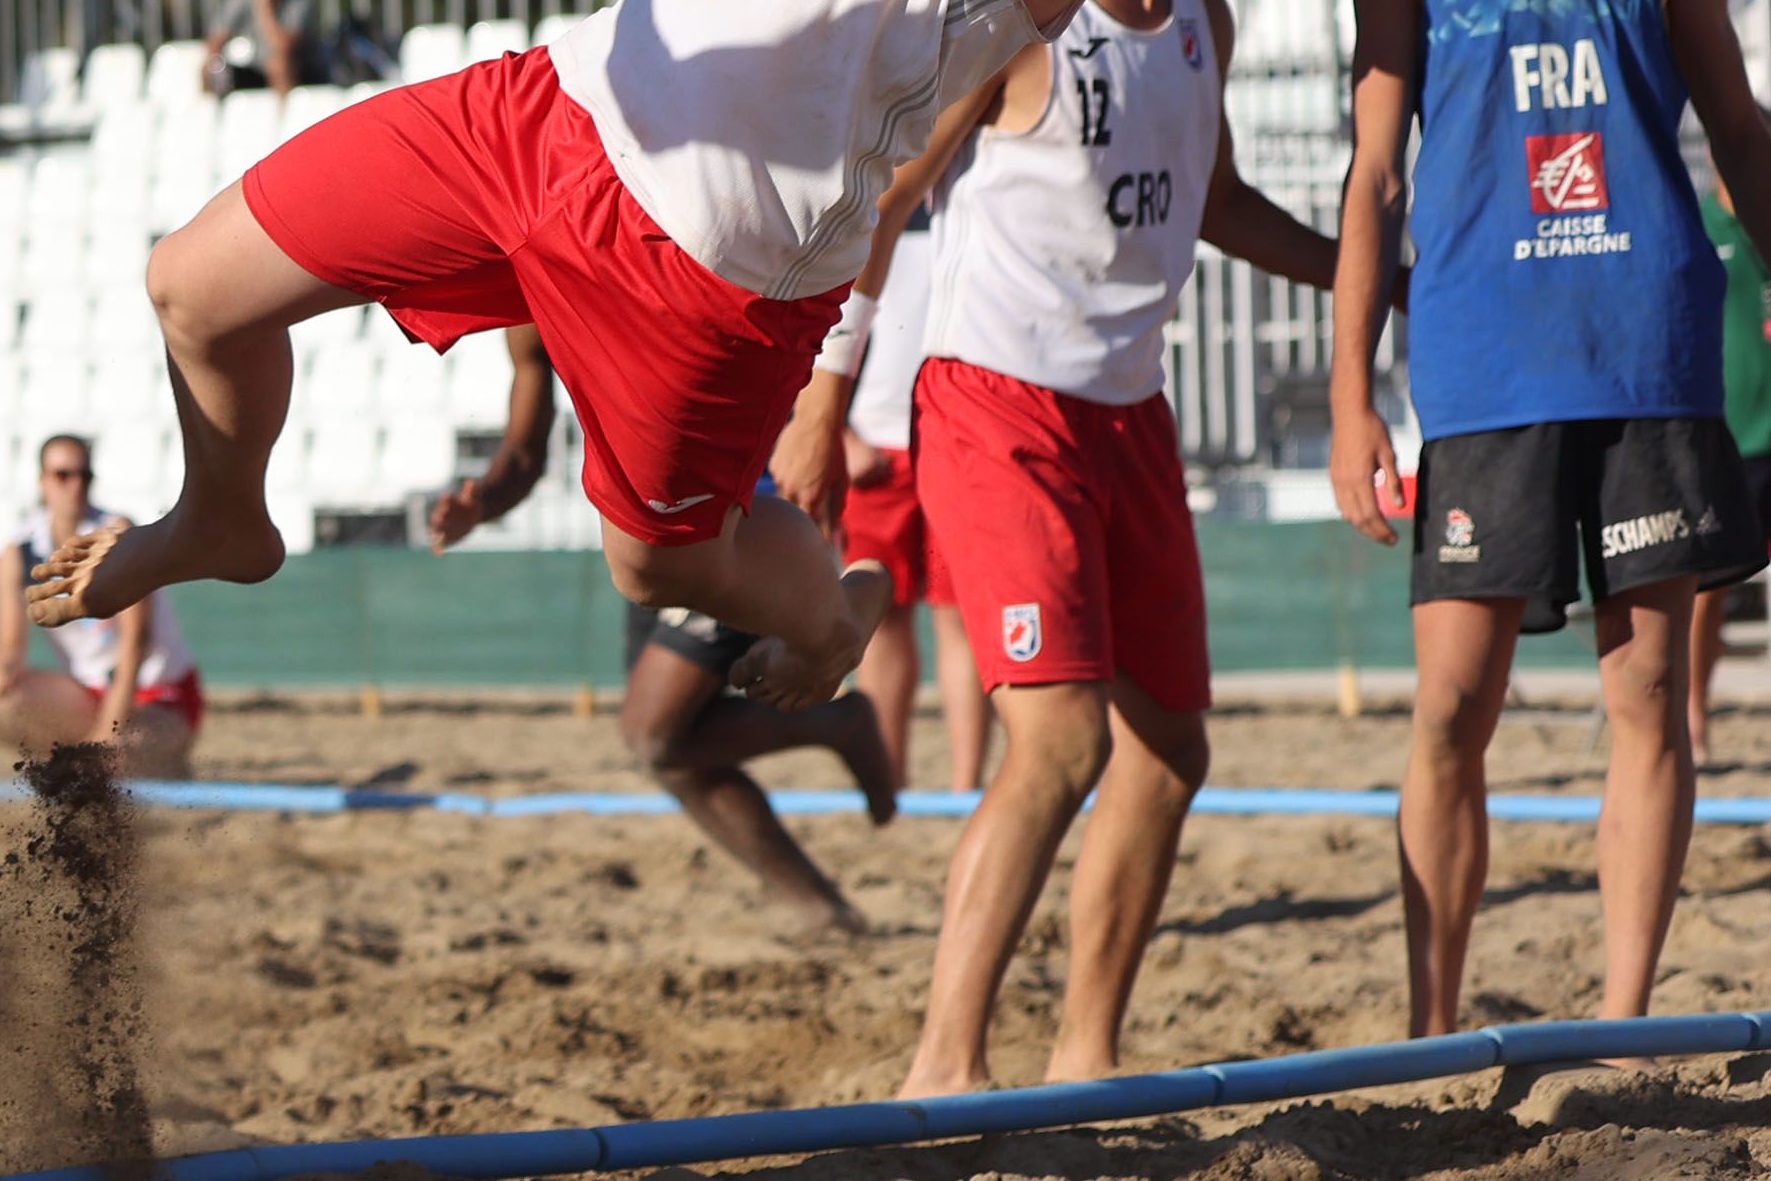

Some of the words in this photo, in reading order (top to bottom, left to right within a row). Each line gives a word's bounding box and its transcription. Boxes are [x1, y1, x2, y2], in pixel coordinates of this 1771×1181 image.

[1509, 38, 1608, 112] FRA
[1077, 79, 1112, 147] 12
[1106, 170, 1172, 229] CRO
[1537, 214, 1606, 237] CAISSE
[1602, 509, 1689, 559] SCHAMPS
